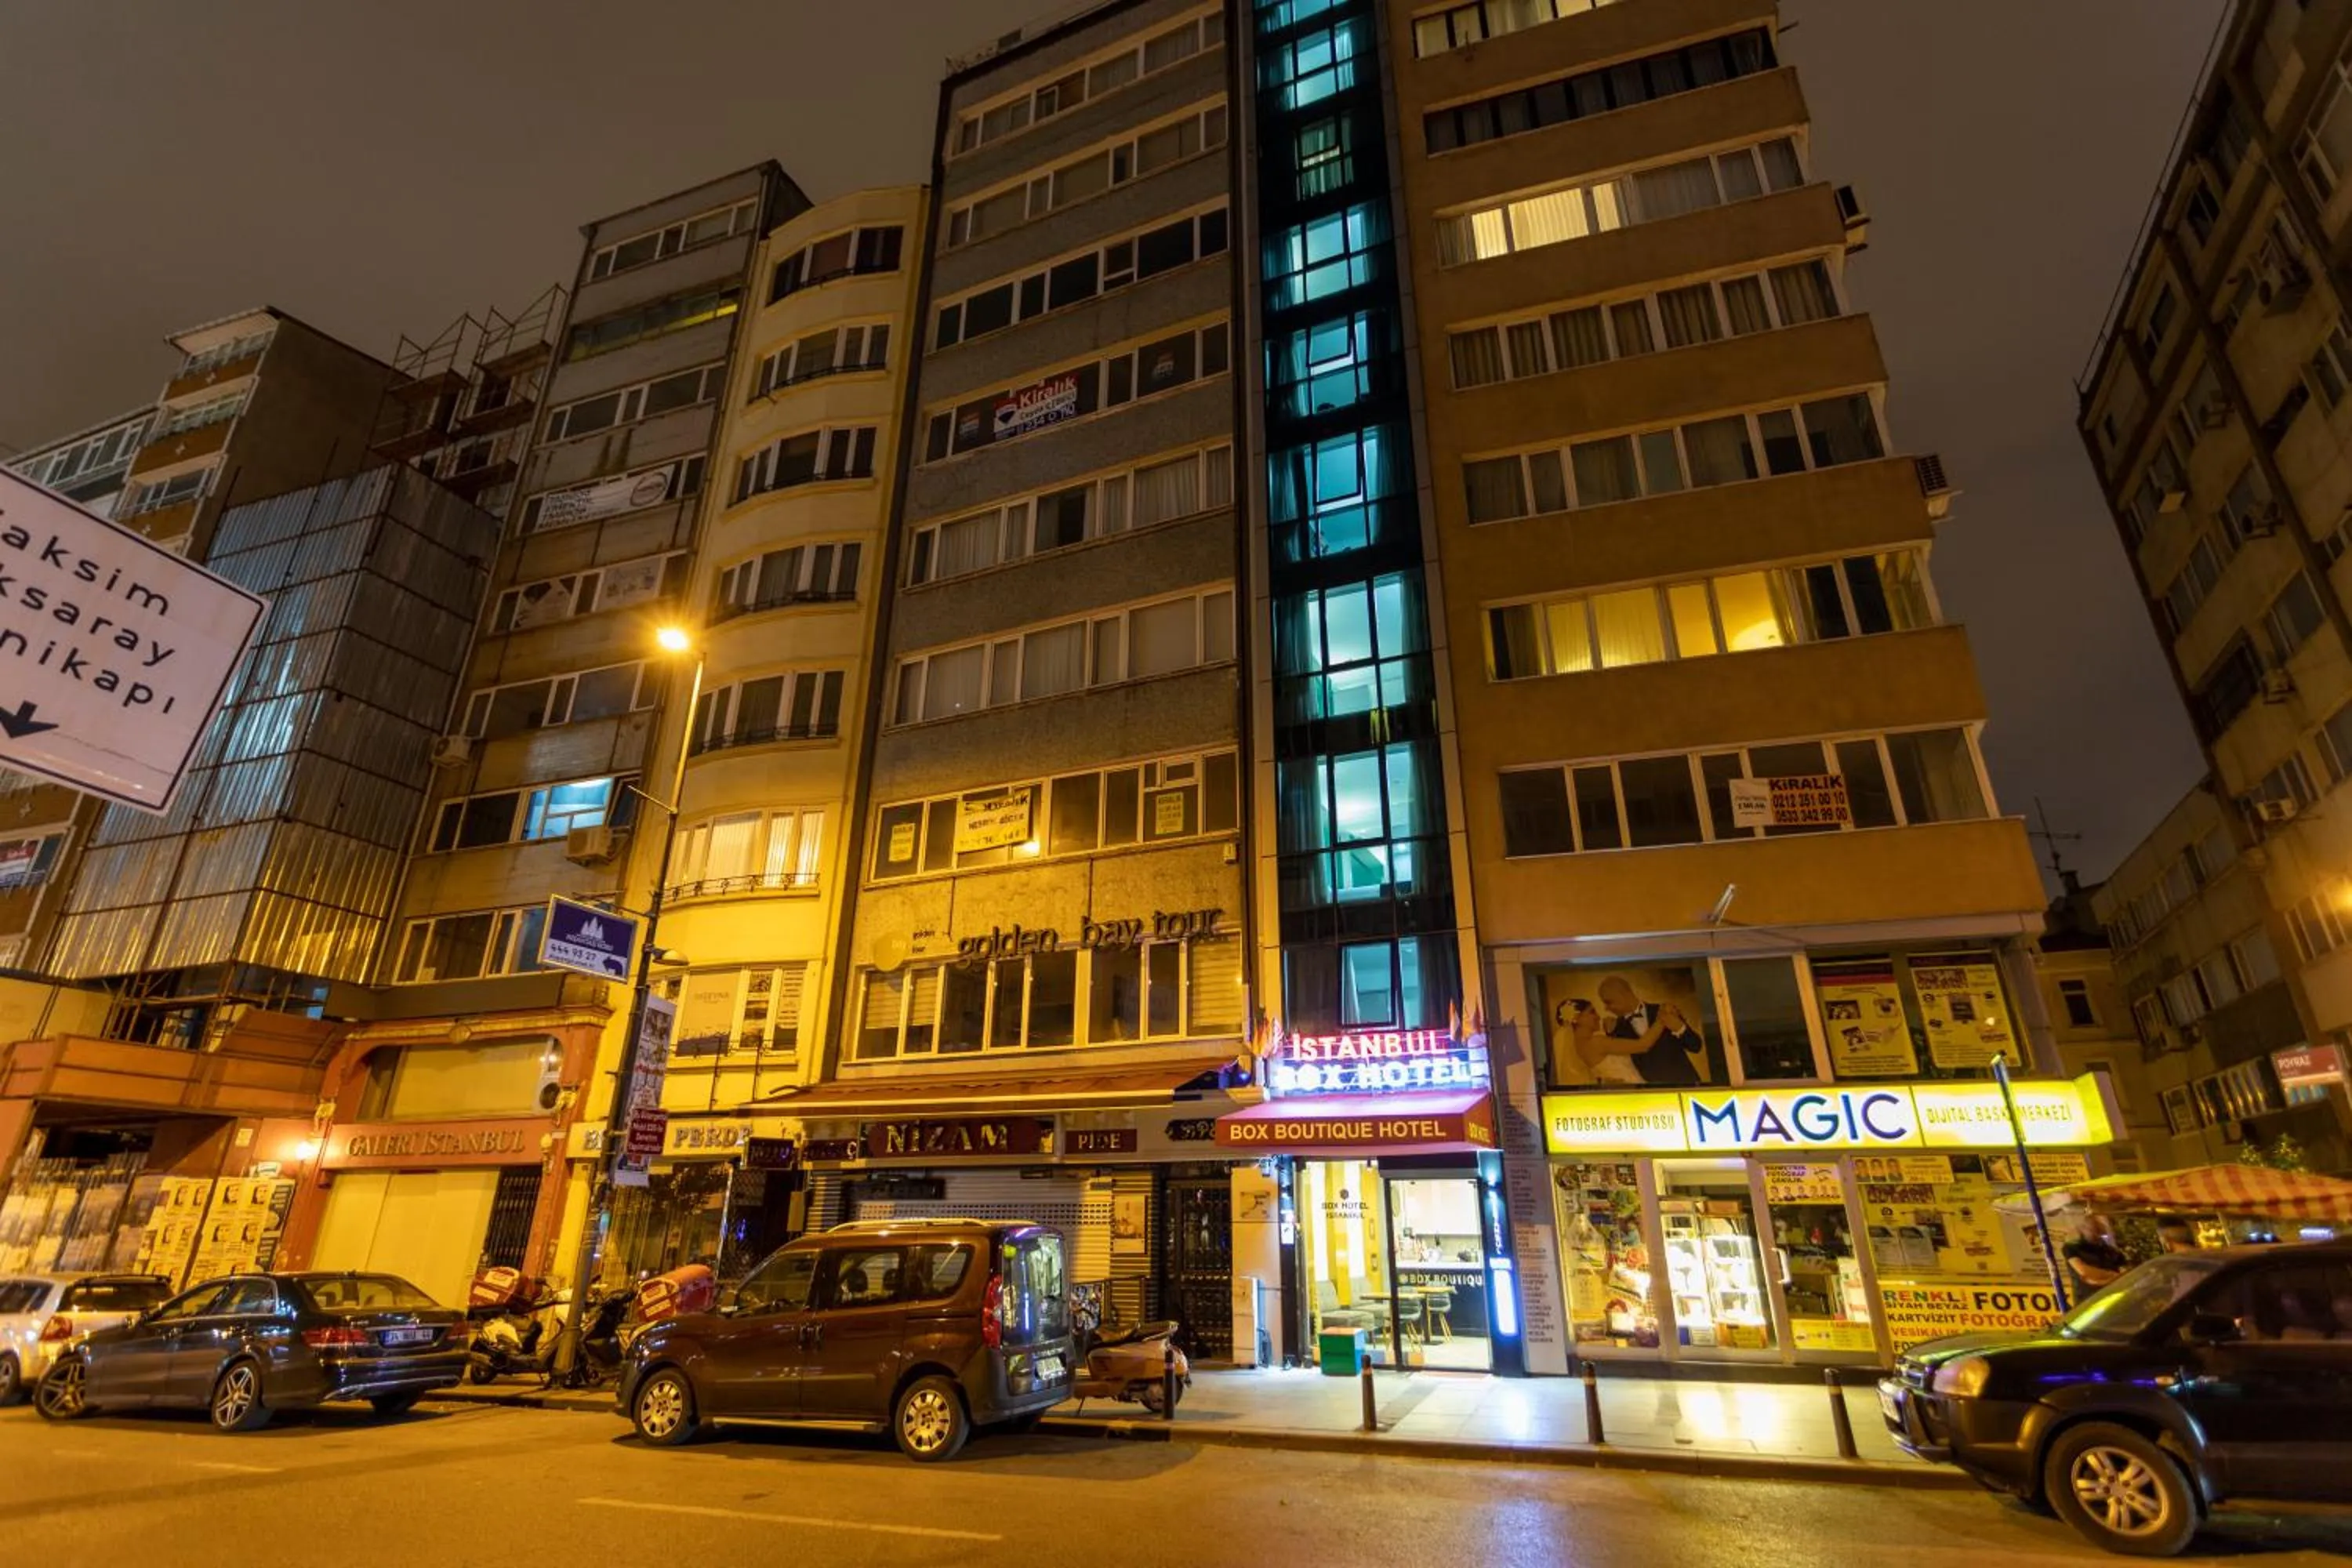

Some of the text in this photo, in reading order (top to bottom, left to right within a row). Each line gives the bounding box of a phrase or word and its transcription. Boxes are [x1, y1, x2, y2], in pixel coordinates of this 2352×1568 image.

[0, 510, 169, 616] aksim
[958, 908, 1223, 970] golden bay tour
[1275, 1057, 1469, 1091] BOX HOTEL
[1230, 1123, 1269, 1141] BOX
[1274, 1122, 1374, 1139] BOUTIQUE
[1379, 1120, 1446, 1138] HOTEL
[1690, 1093, 1907, 1142] MAGIC
[1882, 1288, 1967, 1303] RENKLİ
[1887, 1312, 1957, 1323] KARTVİZİT
